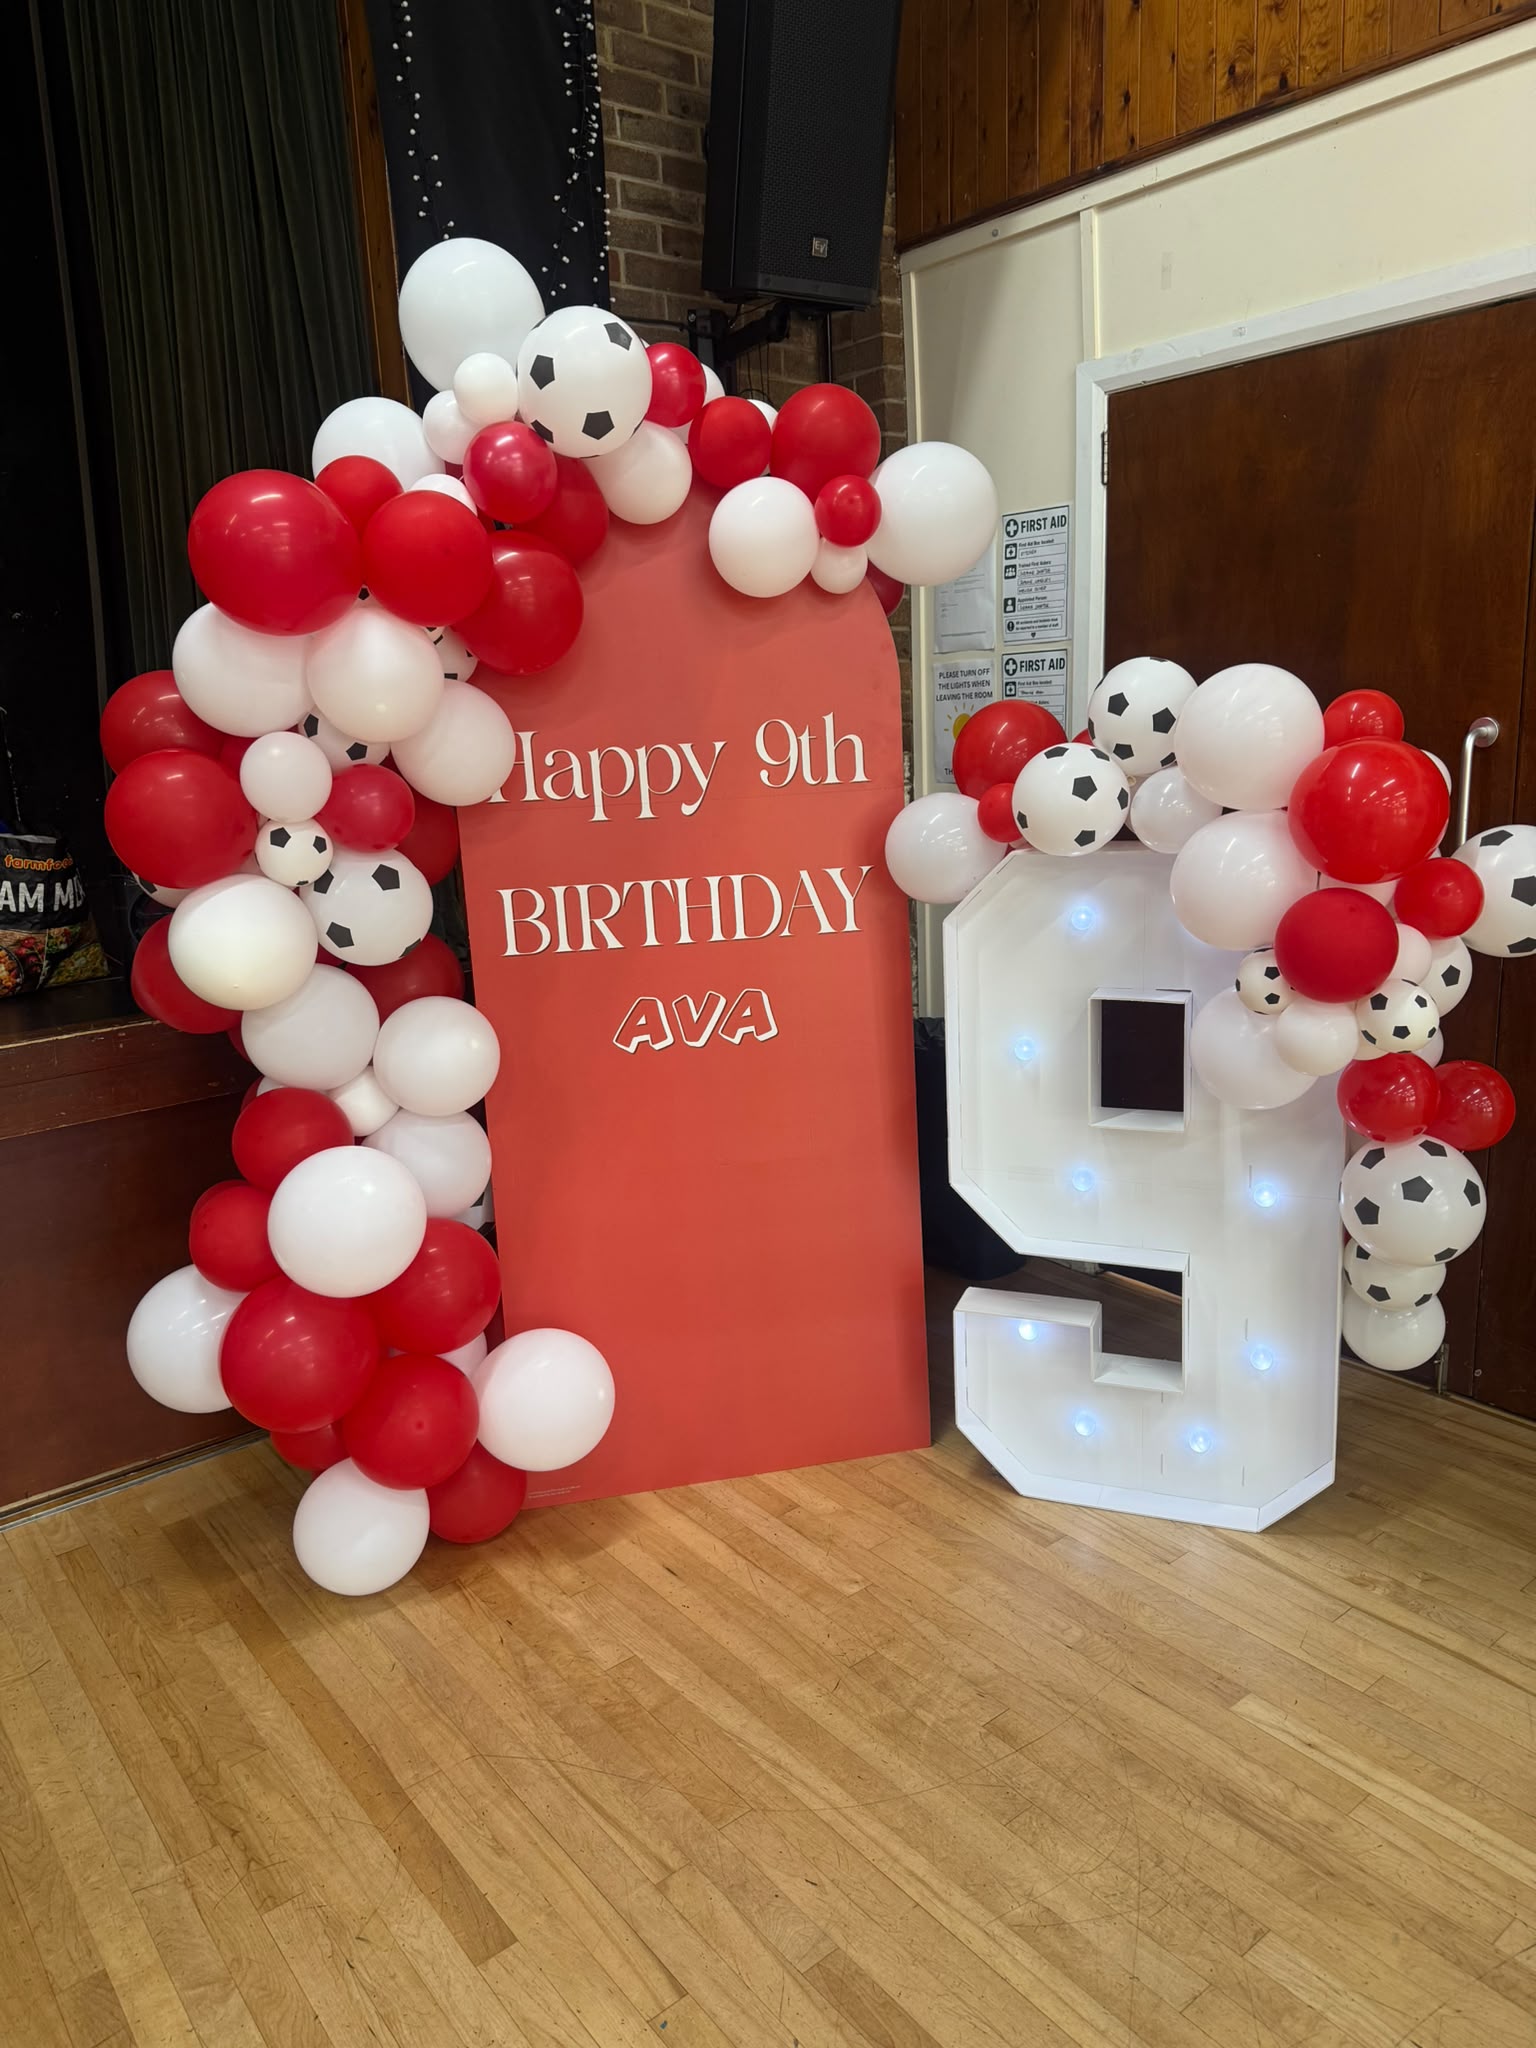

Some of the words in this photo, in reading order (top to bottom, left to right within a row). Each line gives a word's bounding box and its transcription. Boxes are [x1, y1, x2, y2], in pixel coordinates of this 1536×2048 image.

[1021, 517, 1048, 533] FIRST
[1050, 515, 1067, 529] AID
[939, 671, 959, 679] PLEASE
[977, 668, 990, 676] OFF
[1020, 659, 1046, 673] FIRST
[1048, 657, 1066, 670] AID
[938, 682, 949, 690] THE
[950, 681, 971, 690] LIGHTS
[971, 680, 991, 688] WHEN
[936, 693, 961, 701] LEAVING
[962, 692, 973, 700] THE
[974, 691, 993, 699] ROOM
[487, 730, 726, 822] Happy
[755, 712, 871, 787] 9th
[497, 866, 874, 956] BIRTHDAY
[613, 988, 779, 1053] AVA
[943, 848, 1346, 1533] 9
